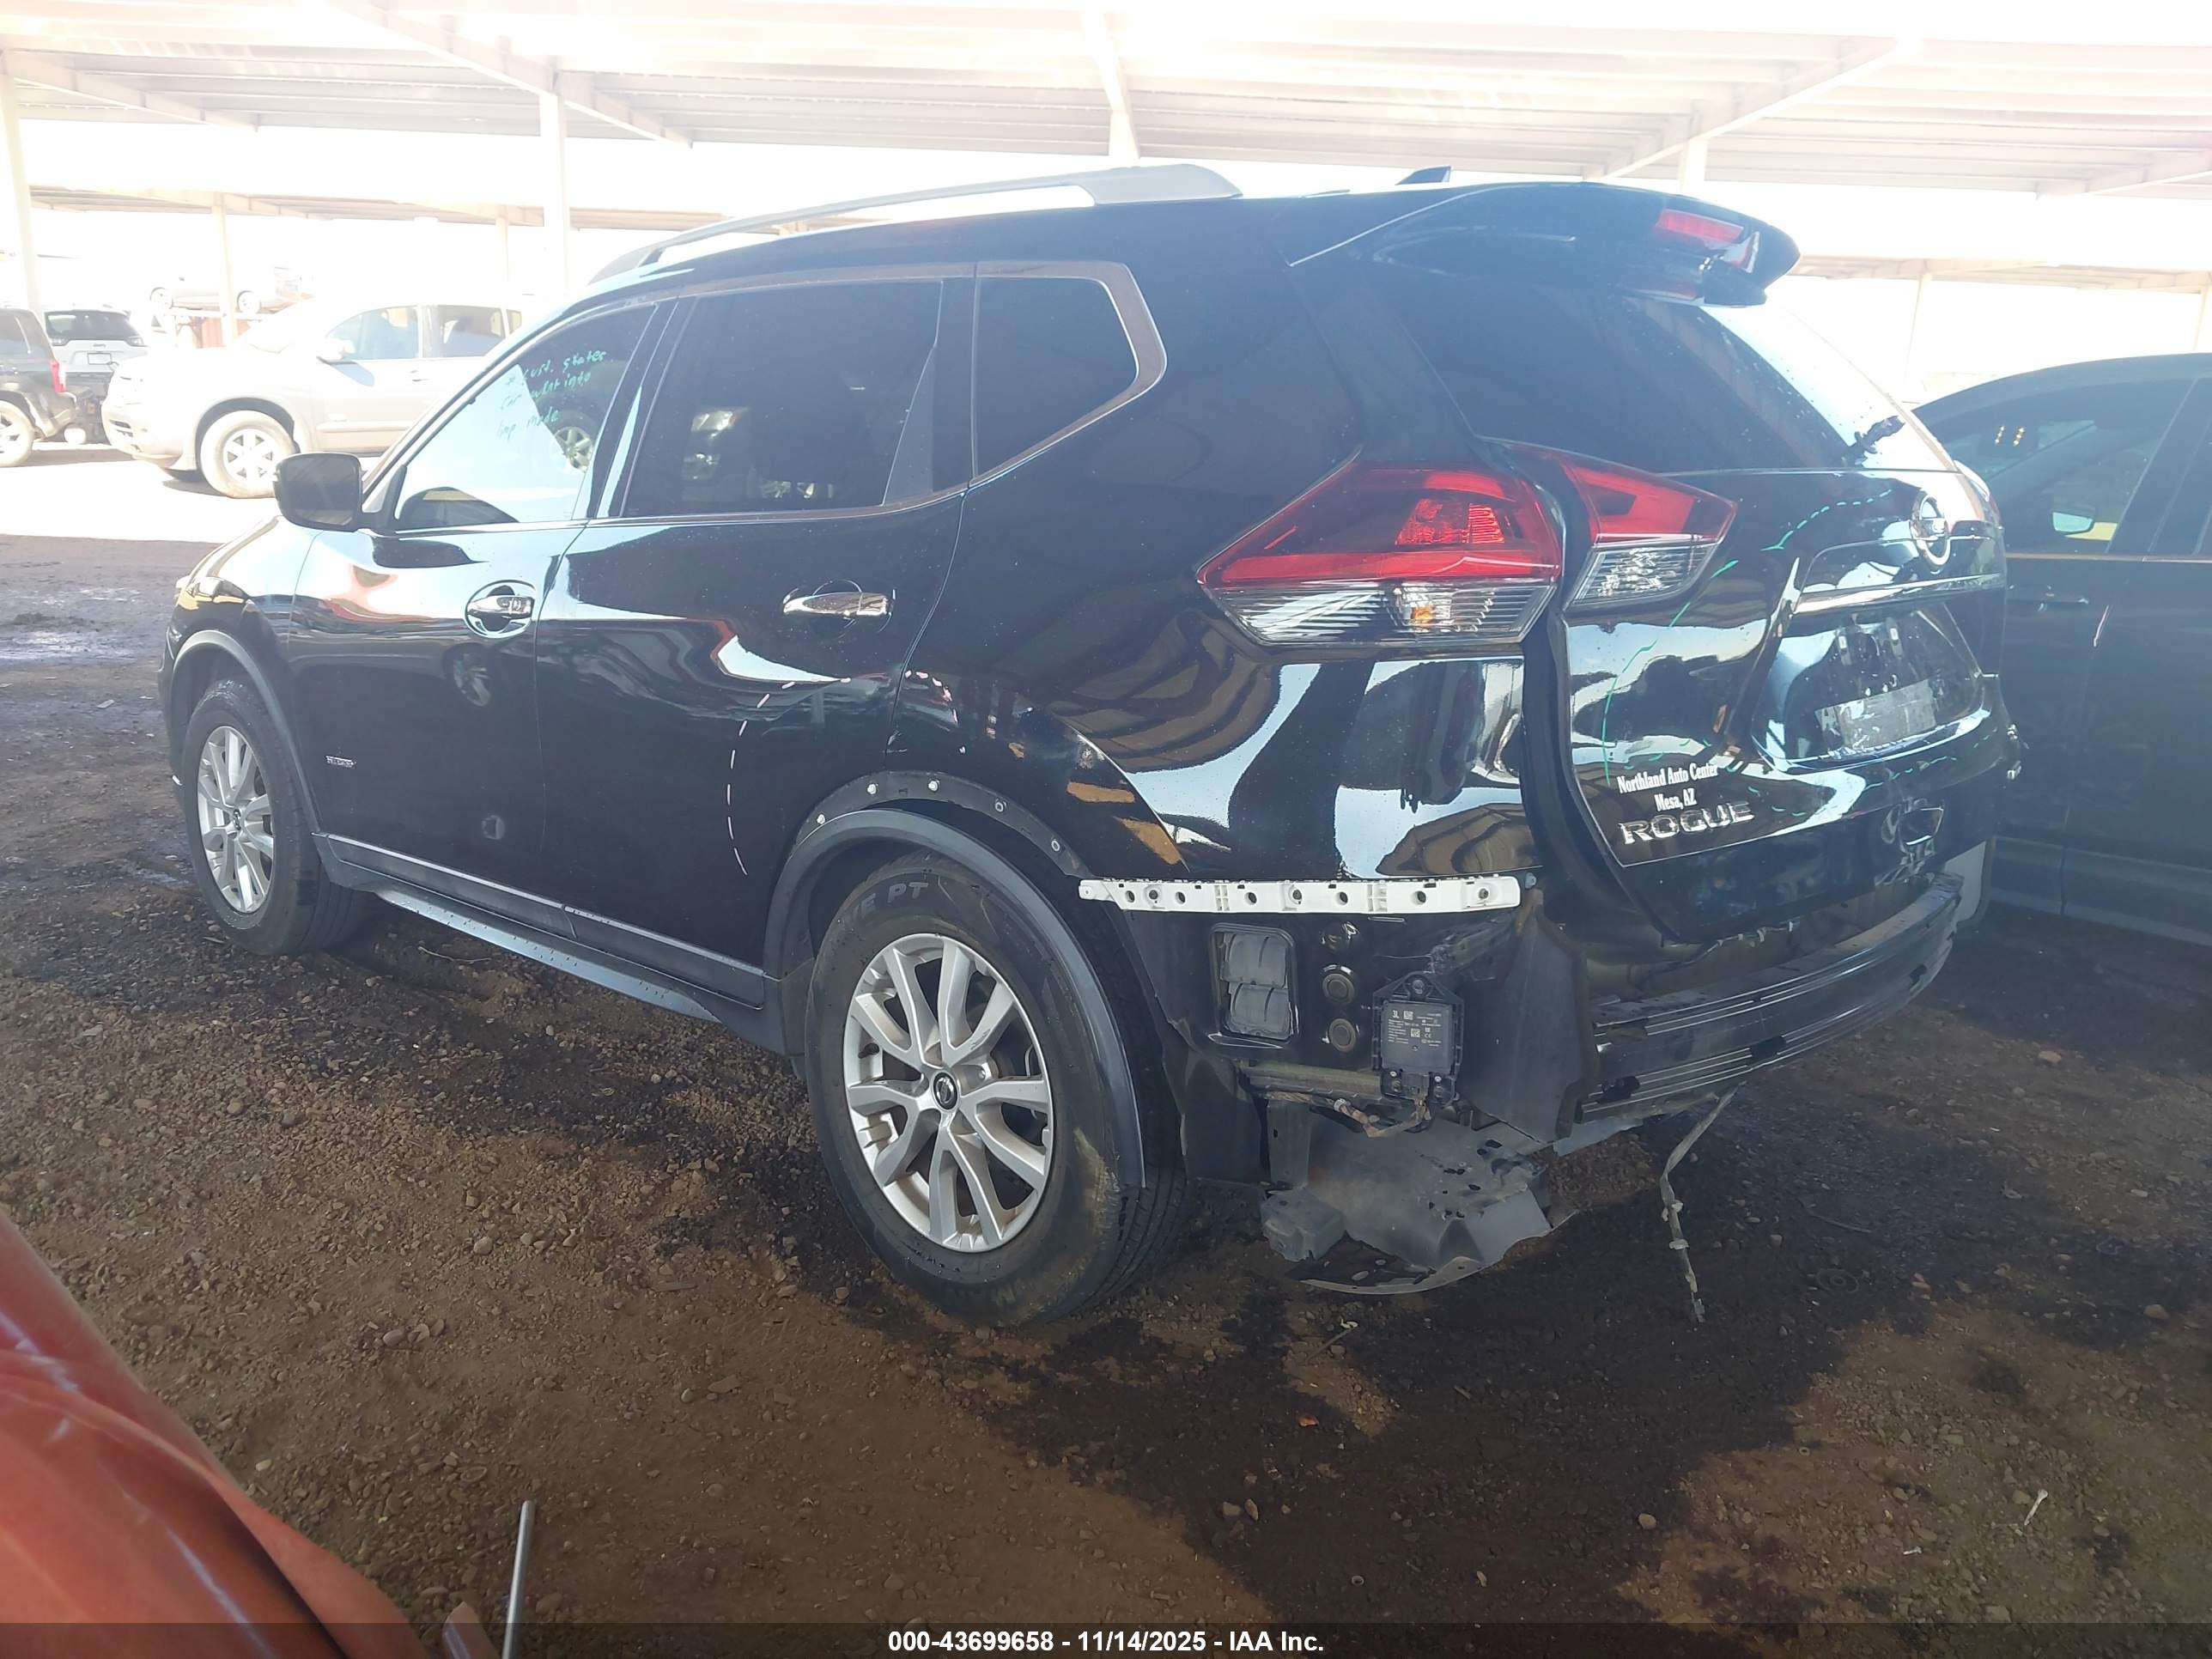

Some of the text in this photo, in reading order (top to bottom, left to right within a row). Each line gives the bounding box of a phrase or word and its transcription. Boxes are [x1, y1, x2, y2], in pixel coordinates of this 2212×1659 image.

[1617, 763, 1718, 793] Northland Auto Center
[1654, 788, 1698, 812] Mesa, AZ
[1618, 801, 1755, 844] ROGUE
[887, 882, 929, 904] PT
